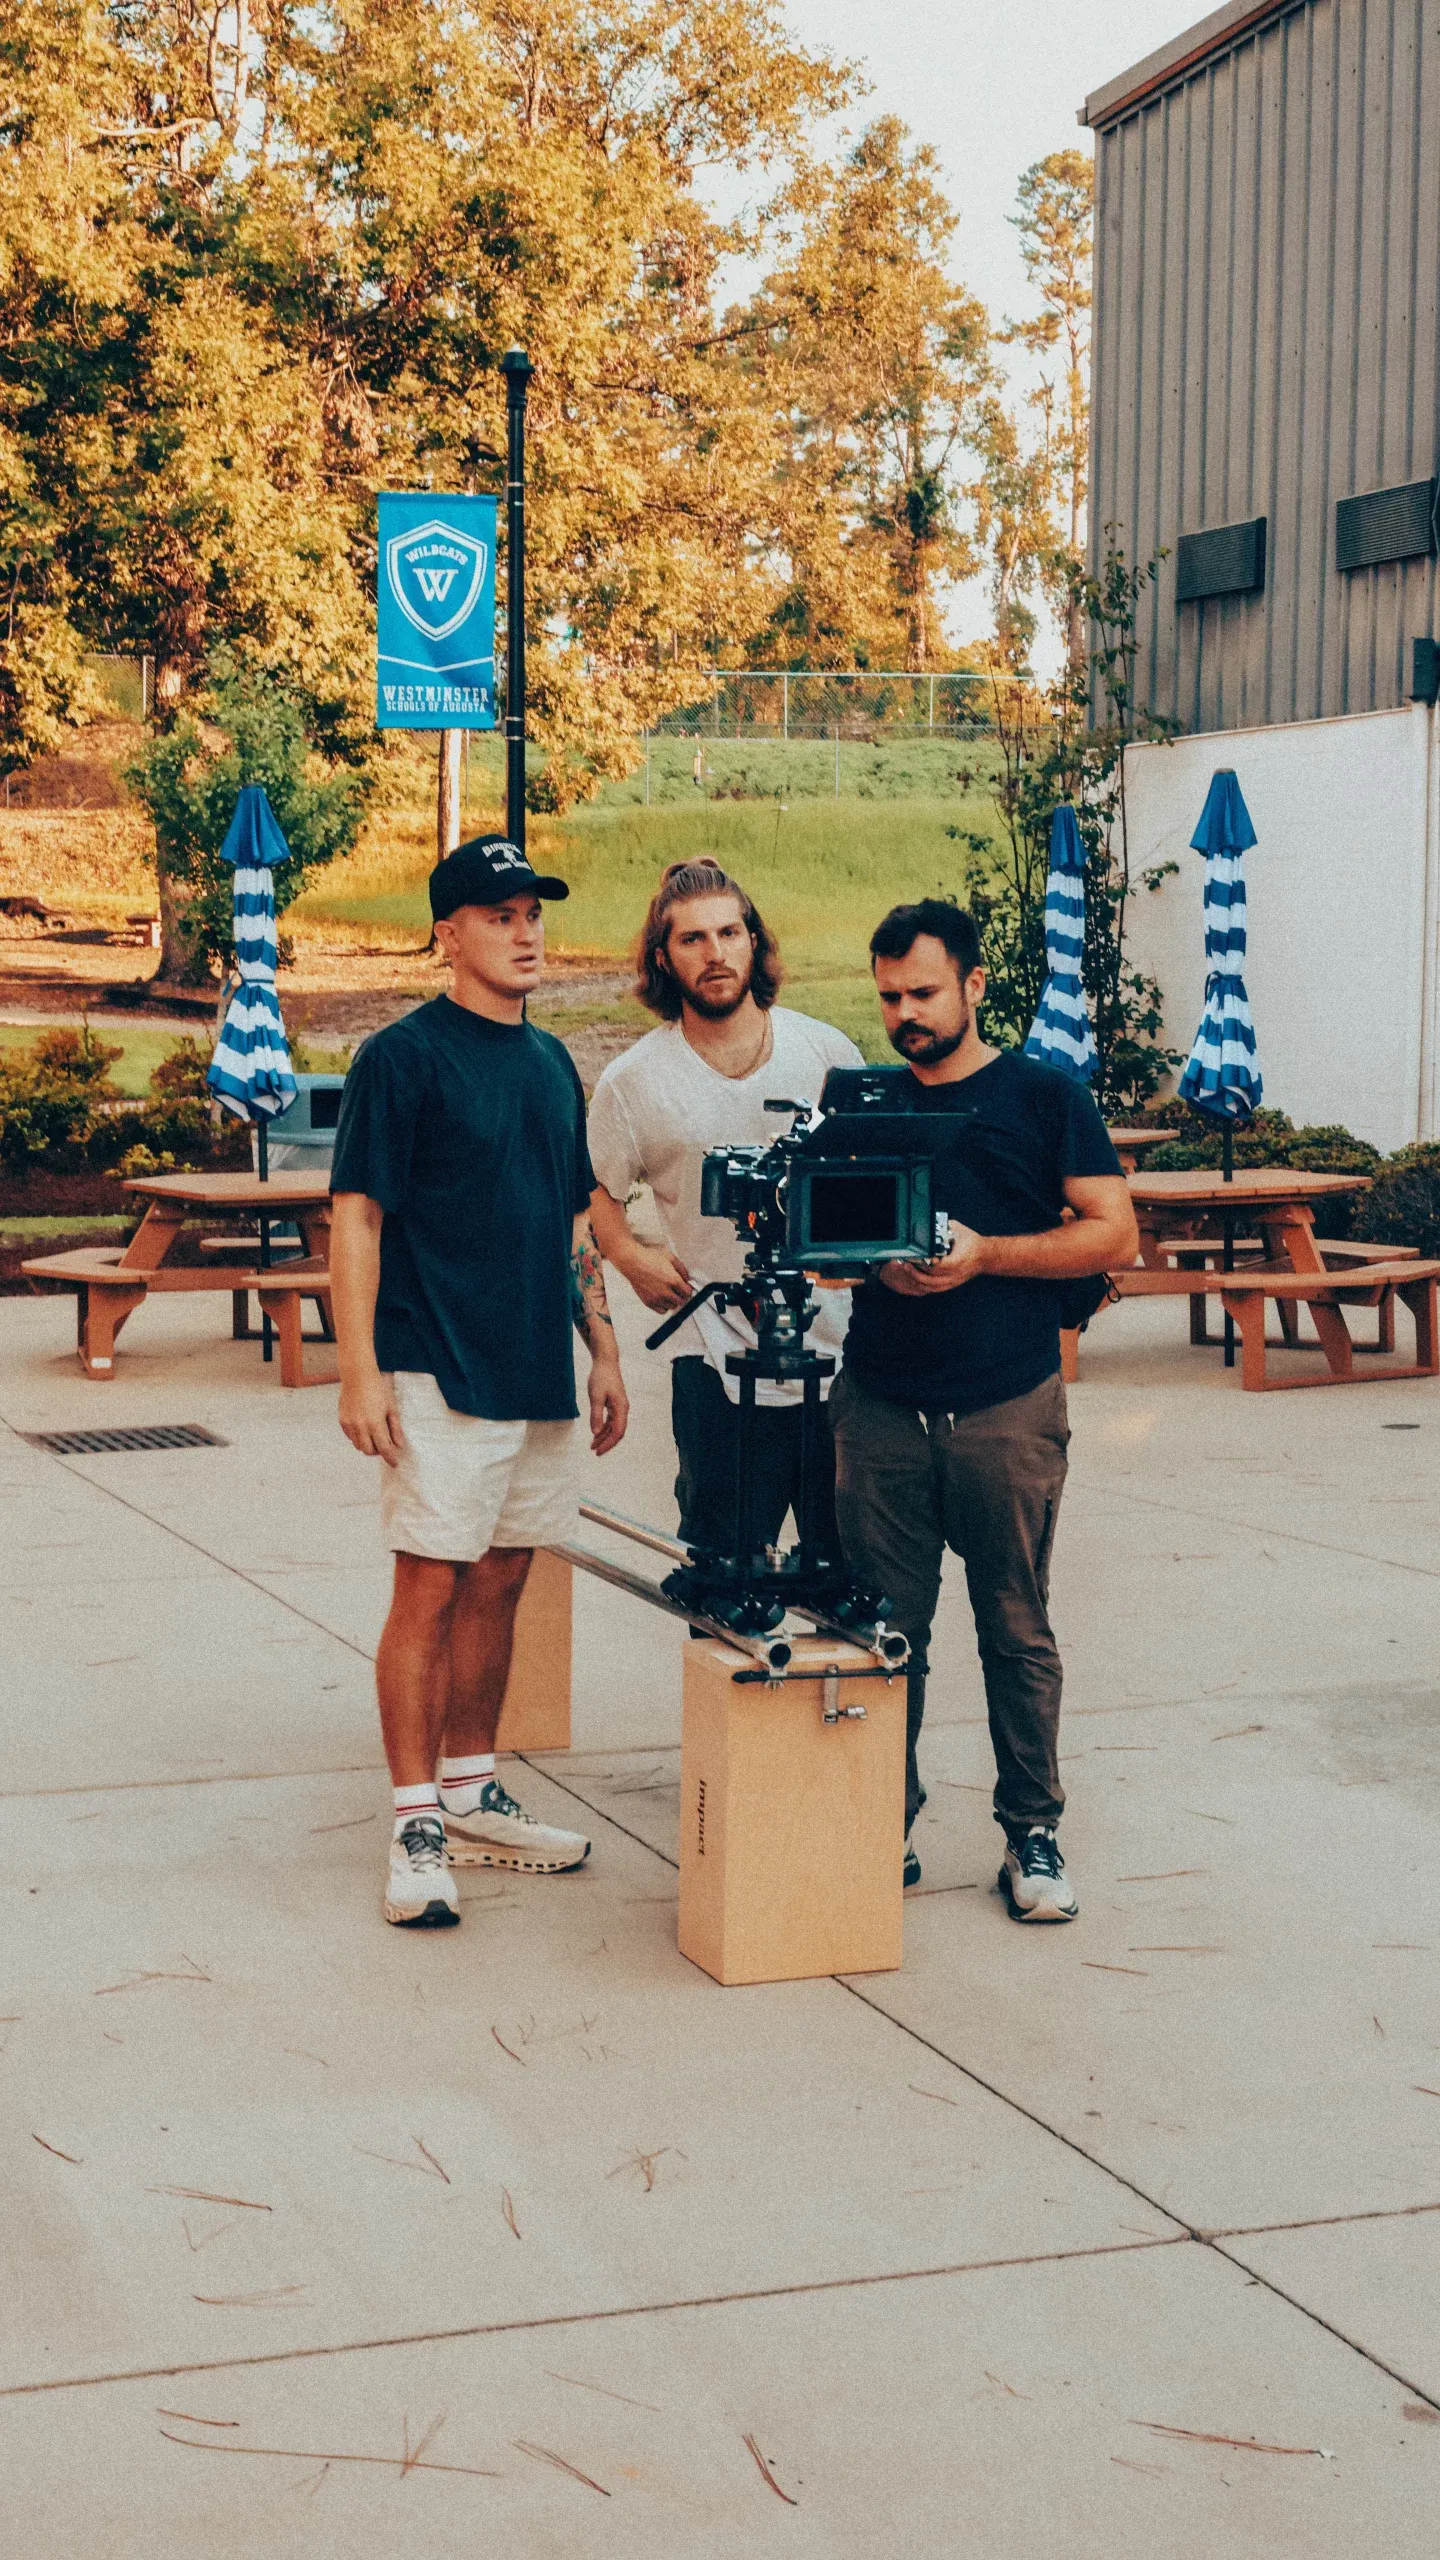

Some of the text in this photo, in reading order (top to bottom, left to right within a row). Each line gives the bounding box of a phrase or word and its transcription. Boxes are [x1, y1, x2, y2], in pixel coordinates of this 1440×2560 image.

[404, 543, 469, 566] WILDCATS
[412, 567, 459, 602] W
[382, 685, 489, 703] WESTMINSTER
[386, 700, 486, 713] SCHOOLS OF AUGUSTA
[698, 1779, 707, 1856] impact
